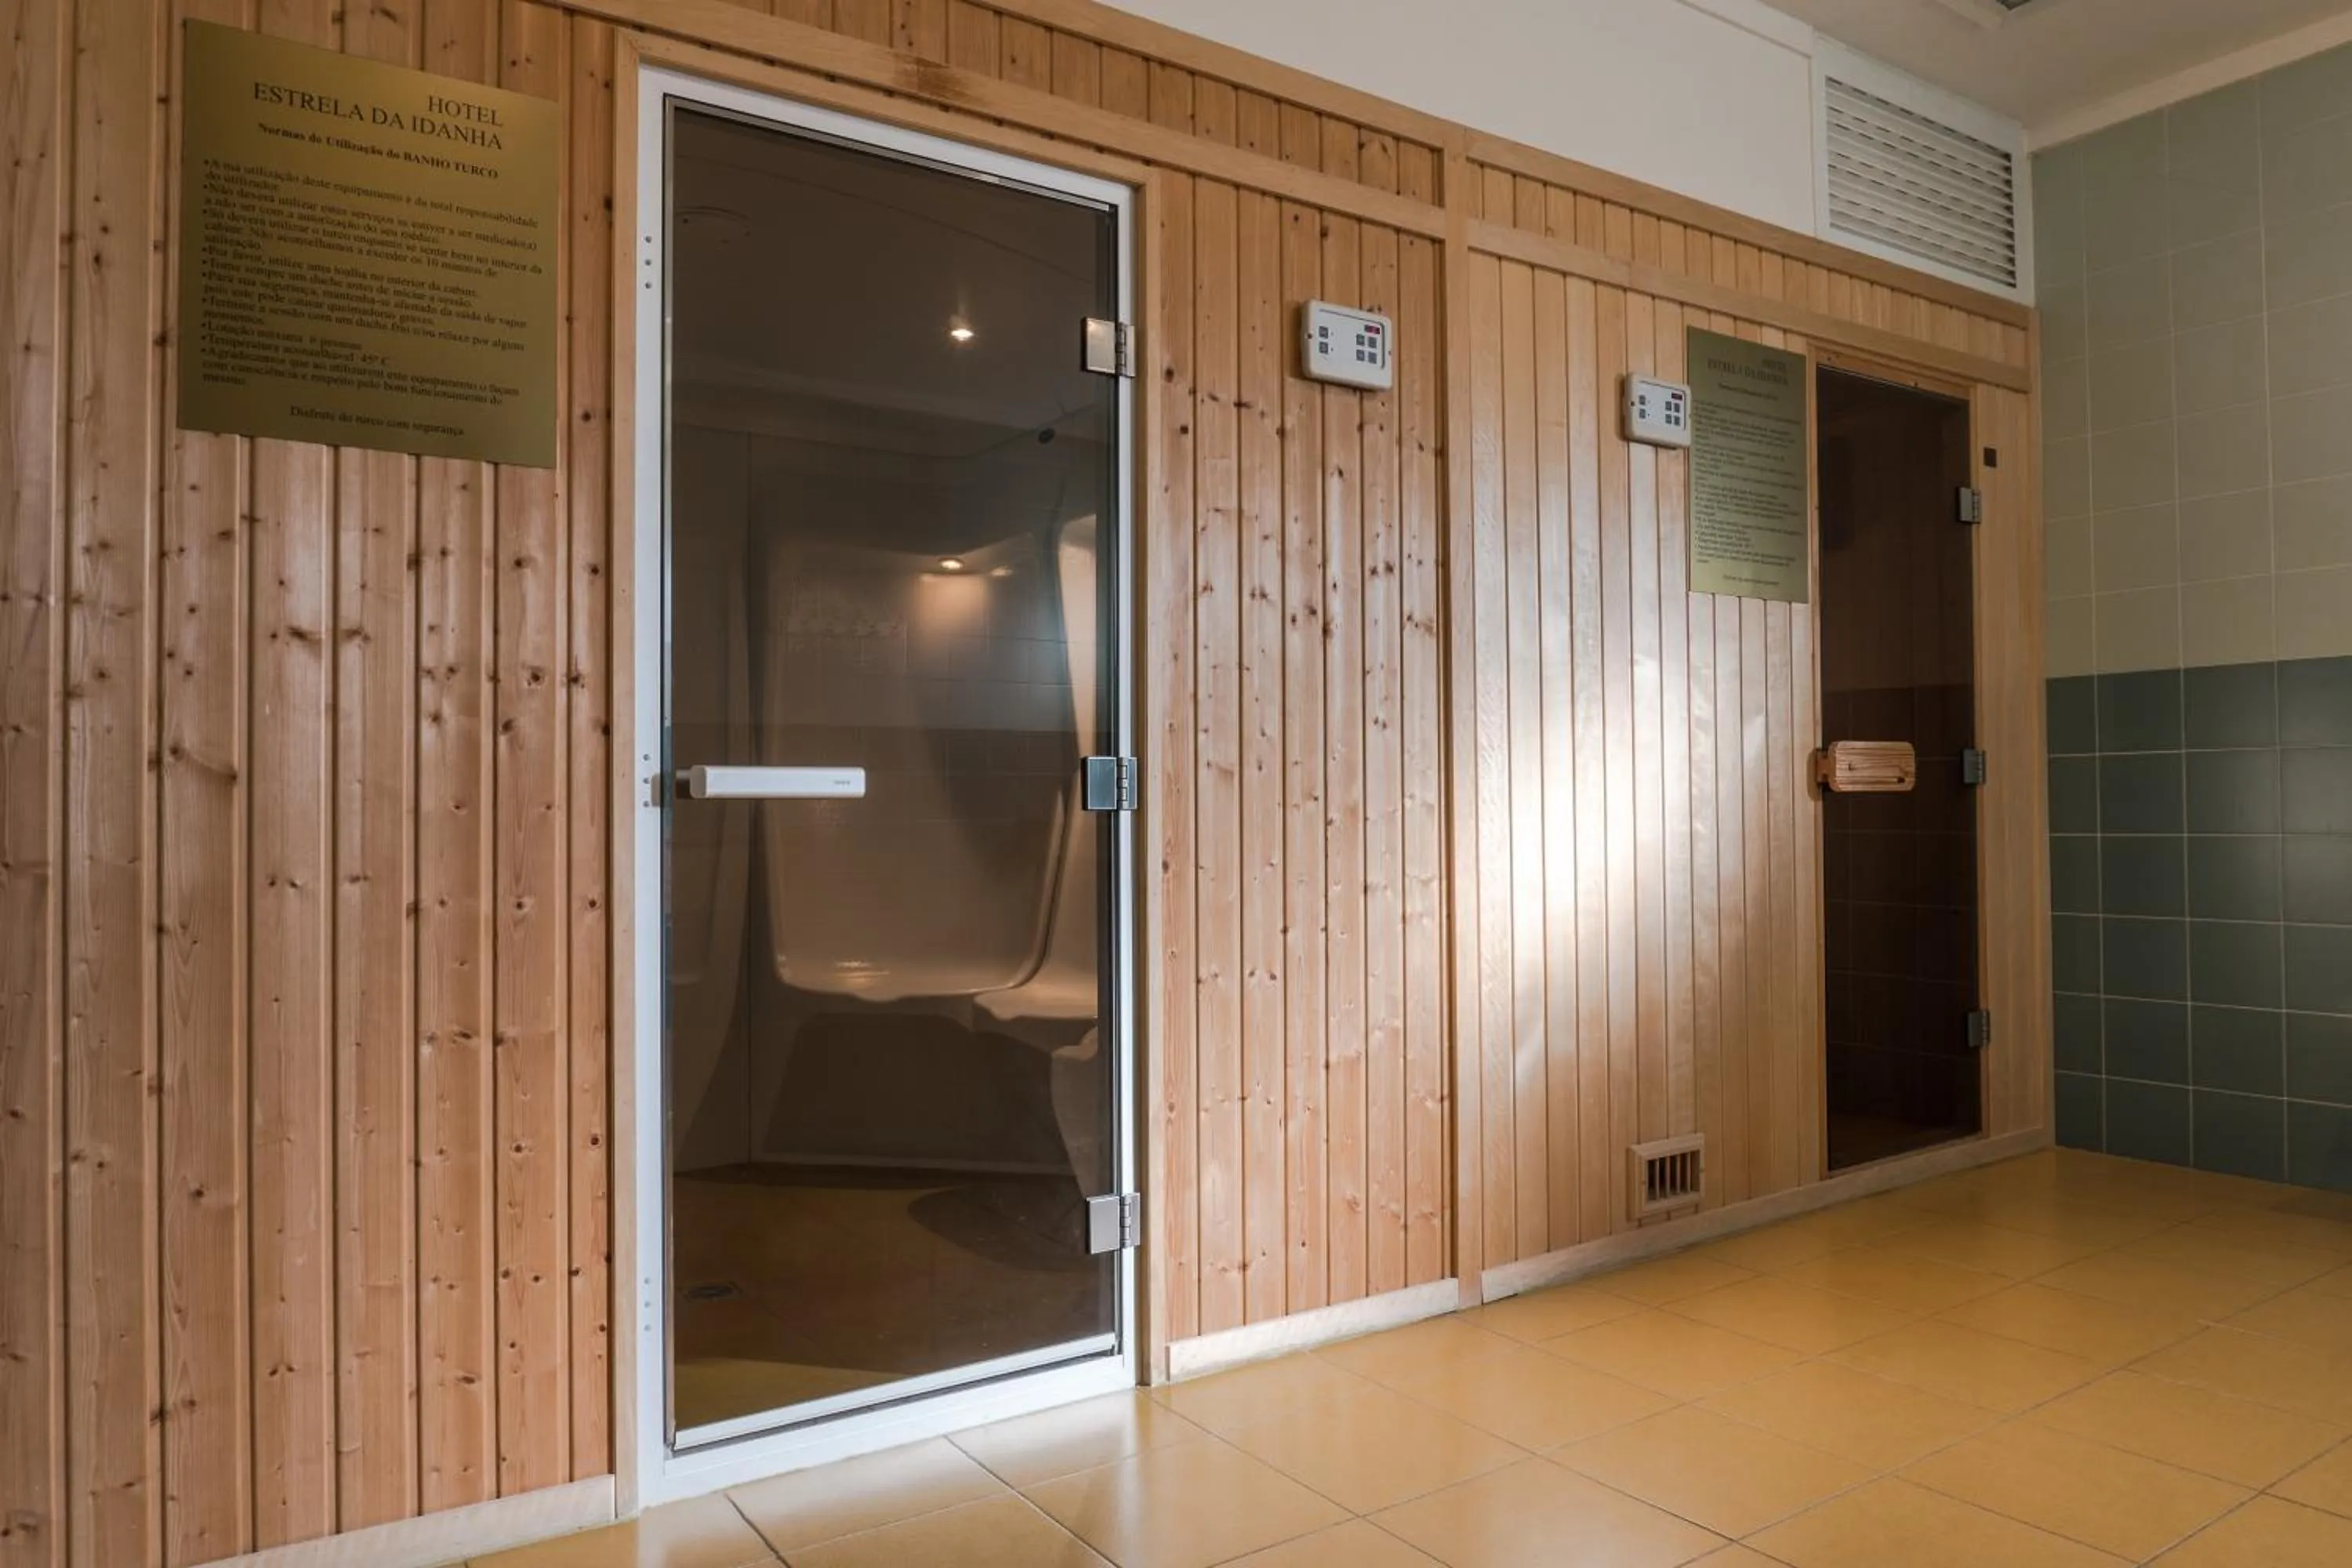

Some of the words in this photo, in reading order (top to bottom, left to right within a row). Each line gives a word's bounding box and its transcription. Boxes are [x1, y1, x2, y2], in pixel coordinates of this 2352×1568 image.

[253, 82, 364, 121] ESTRELA
[372, 106, 404, 129] DA
[411, 114, 502, 151] IDANHA
[428, 94, 503, 128] HOTEL
[258, 122, 304, 142] Normas
[404, 151, 449, 169] BANHO
[455, 161, 498, 179] TURCO
